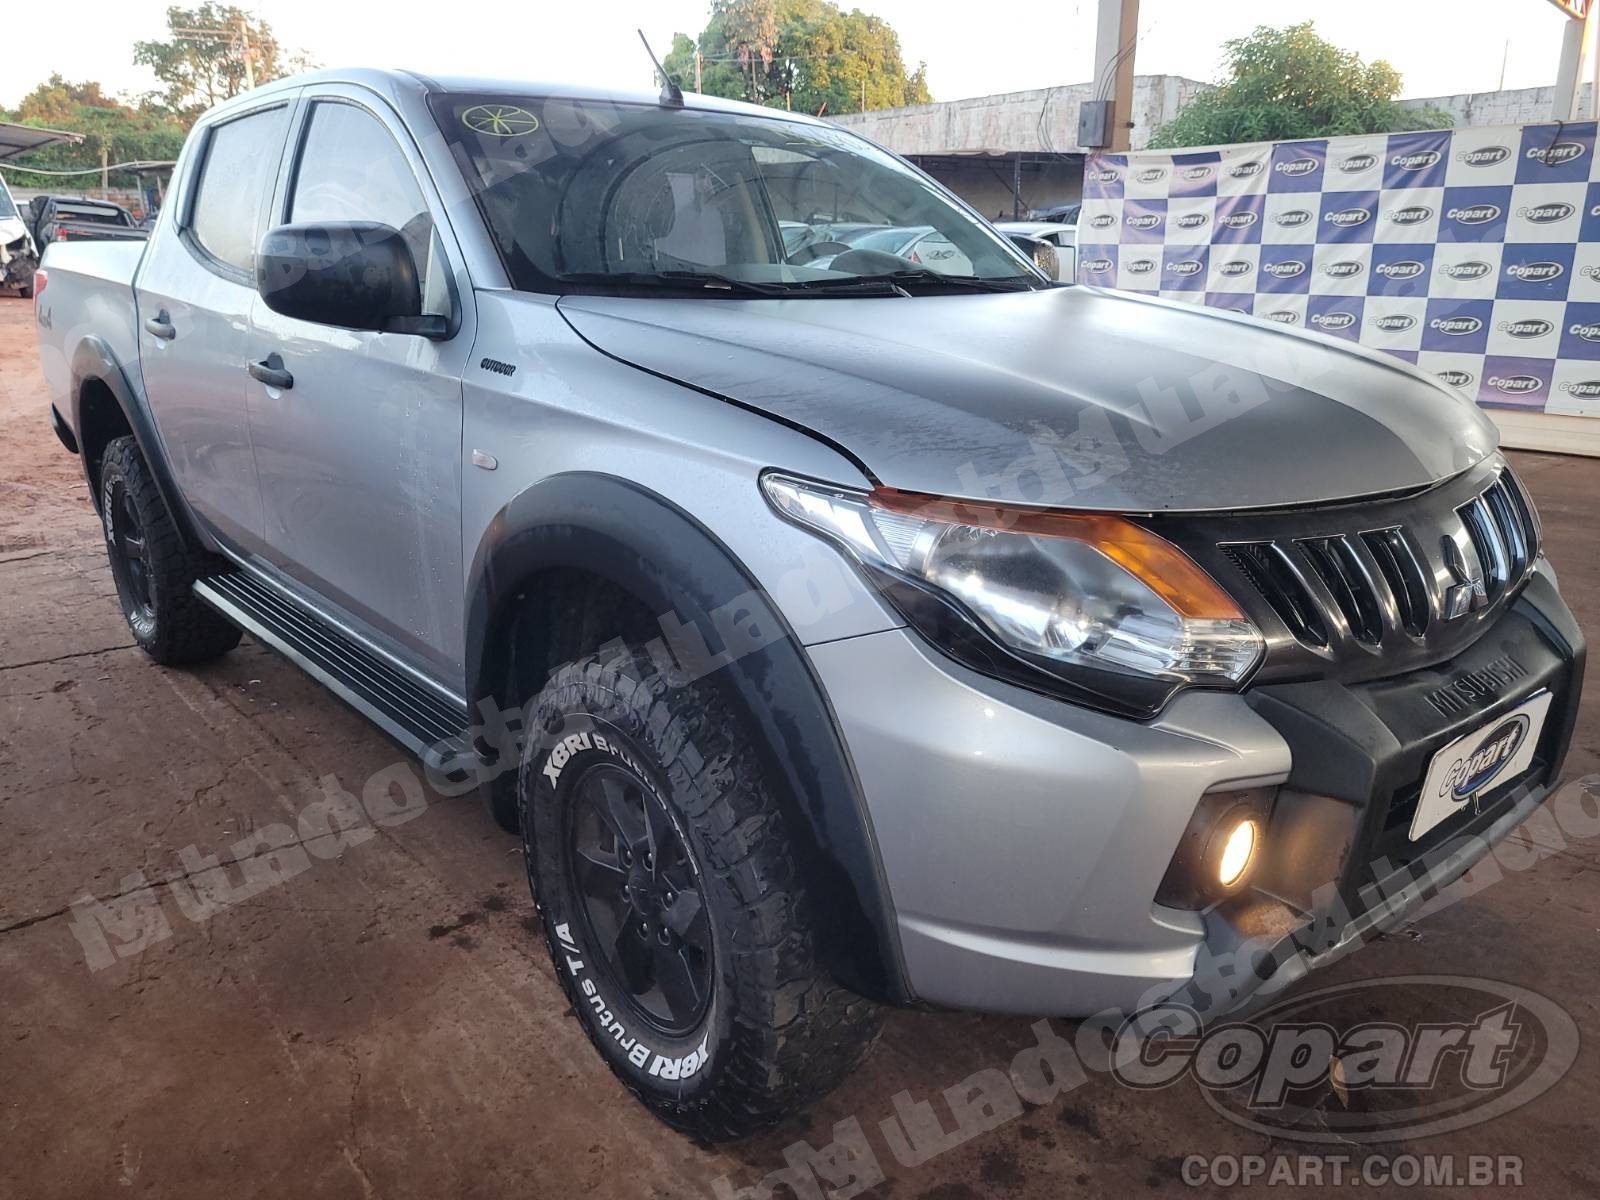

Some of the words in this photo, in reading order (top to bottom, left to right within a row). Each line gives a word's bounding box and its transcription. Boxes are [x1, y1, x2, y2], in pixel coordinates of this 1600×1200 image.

[1391, 153, 1436, 166] Copart
[1456, 150, 1504, 163] Copart
[1275, 160, 1314, 173] Copart
[1324, 211, 1365, 223] Copart
[1446, 207, 1495, 220] Copart
[1516, 205, 1569, 219] Copart
[1126, 215, 1157, 226] Copart
[1081, 260, 1110, 270] Copart
[1166, 262, 1199, 272] Copart
[1263, 263, 1301, 273] Copart
[1376, 263, 1419, 275] Copart
[1439, 264, 1484, 276] Copart
[1506, 264, 1556, 277] Copart
[1311, 314, 1350, 325] Copart
[1430, 318, 1477, 331] Copart
[1497, 320, 1546, 334] Copart
[480, 357, 516, 377] OUTDOOR
[1488, 376, 1537, 389] Copart
[1424, 655, 1529, 718] MITSUBISHI
[542, 732, 592, 790] XBRI
[1438, 722, 1521, 798] Copart
[555, 922, 585, 976] T/A
[581, 978, 651, 1068] Brutus
[648, 1030, 709, 1081] XBRI
